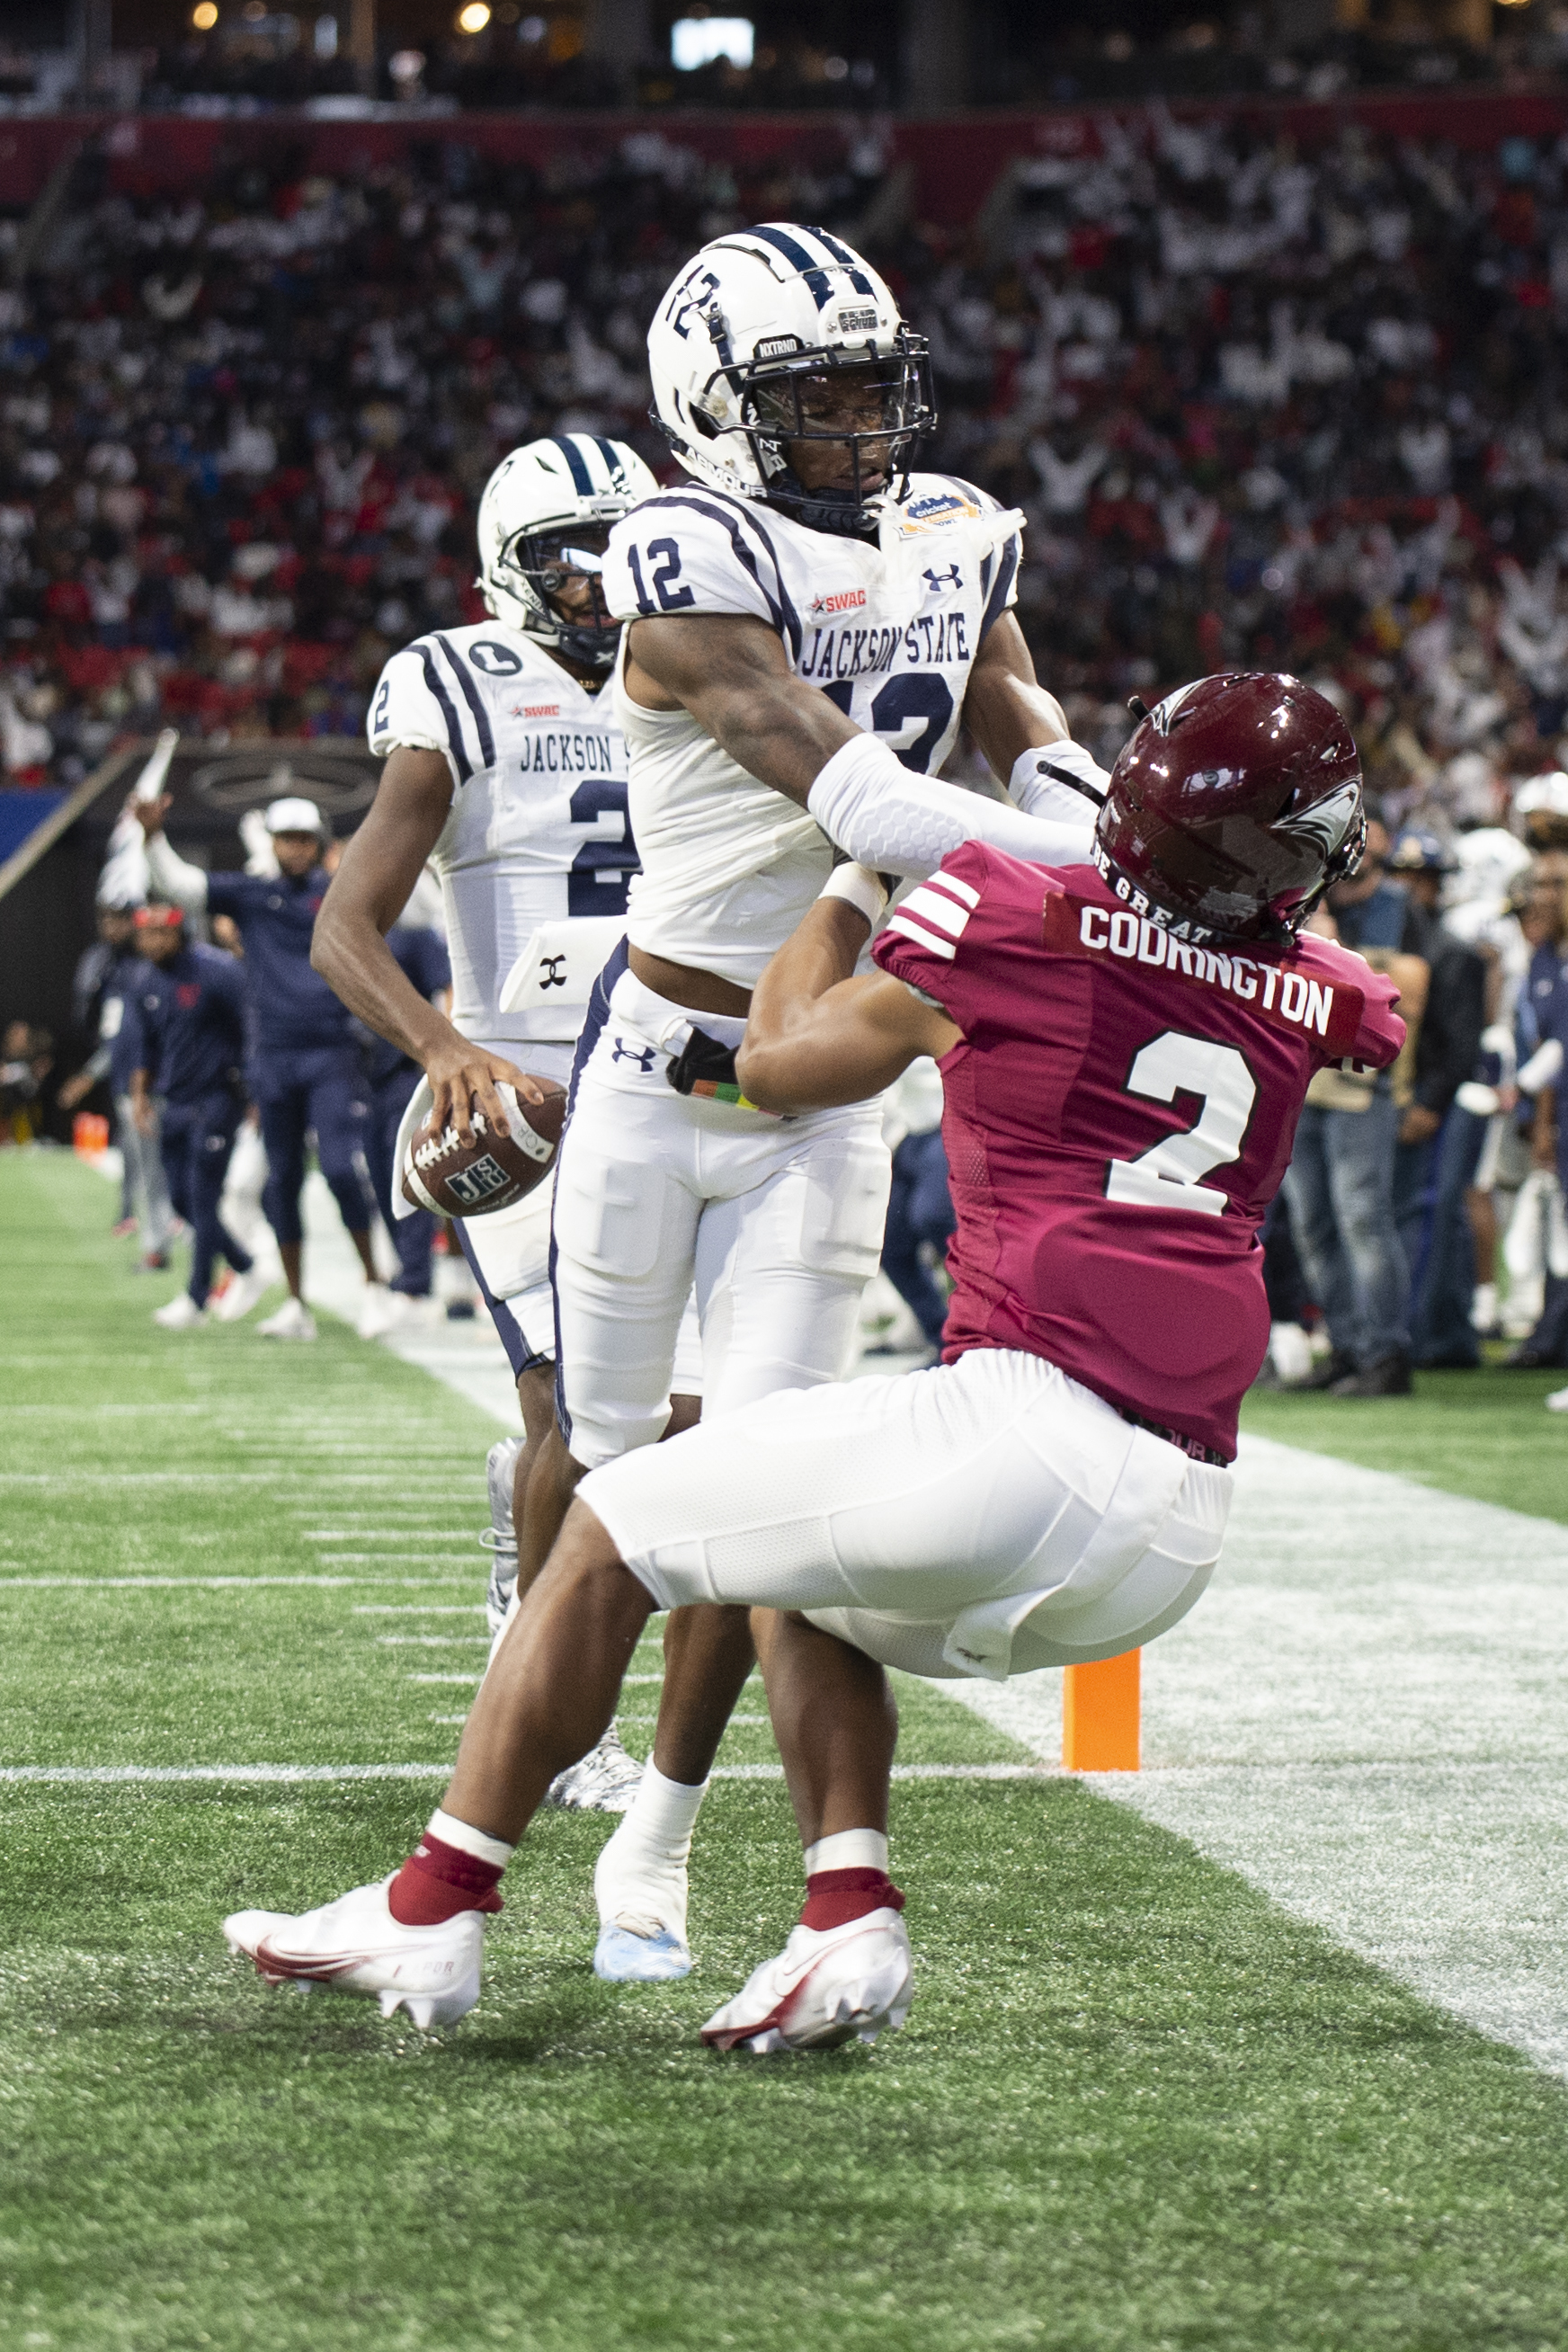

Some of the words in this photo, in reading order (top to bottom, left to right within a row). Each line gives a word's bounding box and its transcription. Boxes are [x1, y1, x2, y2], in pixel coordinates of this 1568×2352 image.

[759, 339, 797, 358] NXTRND
[686, 446, 768, 498] ARMOUR
[915, 502, 953, 518] cricket
[934, 518, 958, 528] OWL
[627, 537, 697, 615] 12
[826, 590, 867, 613] SWAC
[802, 627, 903, 679] JACKSON
[904, 612, 970, 664] STATE
[374, 680, 390, 735] 2
[524, 705, 560, 717] SWAC
[521, 734, 612, 772] JACKSON
[567, 779, 641, 917] 2
[1092, 841, 1111, 880] BE
[1115, 877, 1213, 944] GREAT
[1080, 905, 1334, 1037] CODRINGTON
[1104, 1029, 1260, 1216] 2
